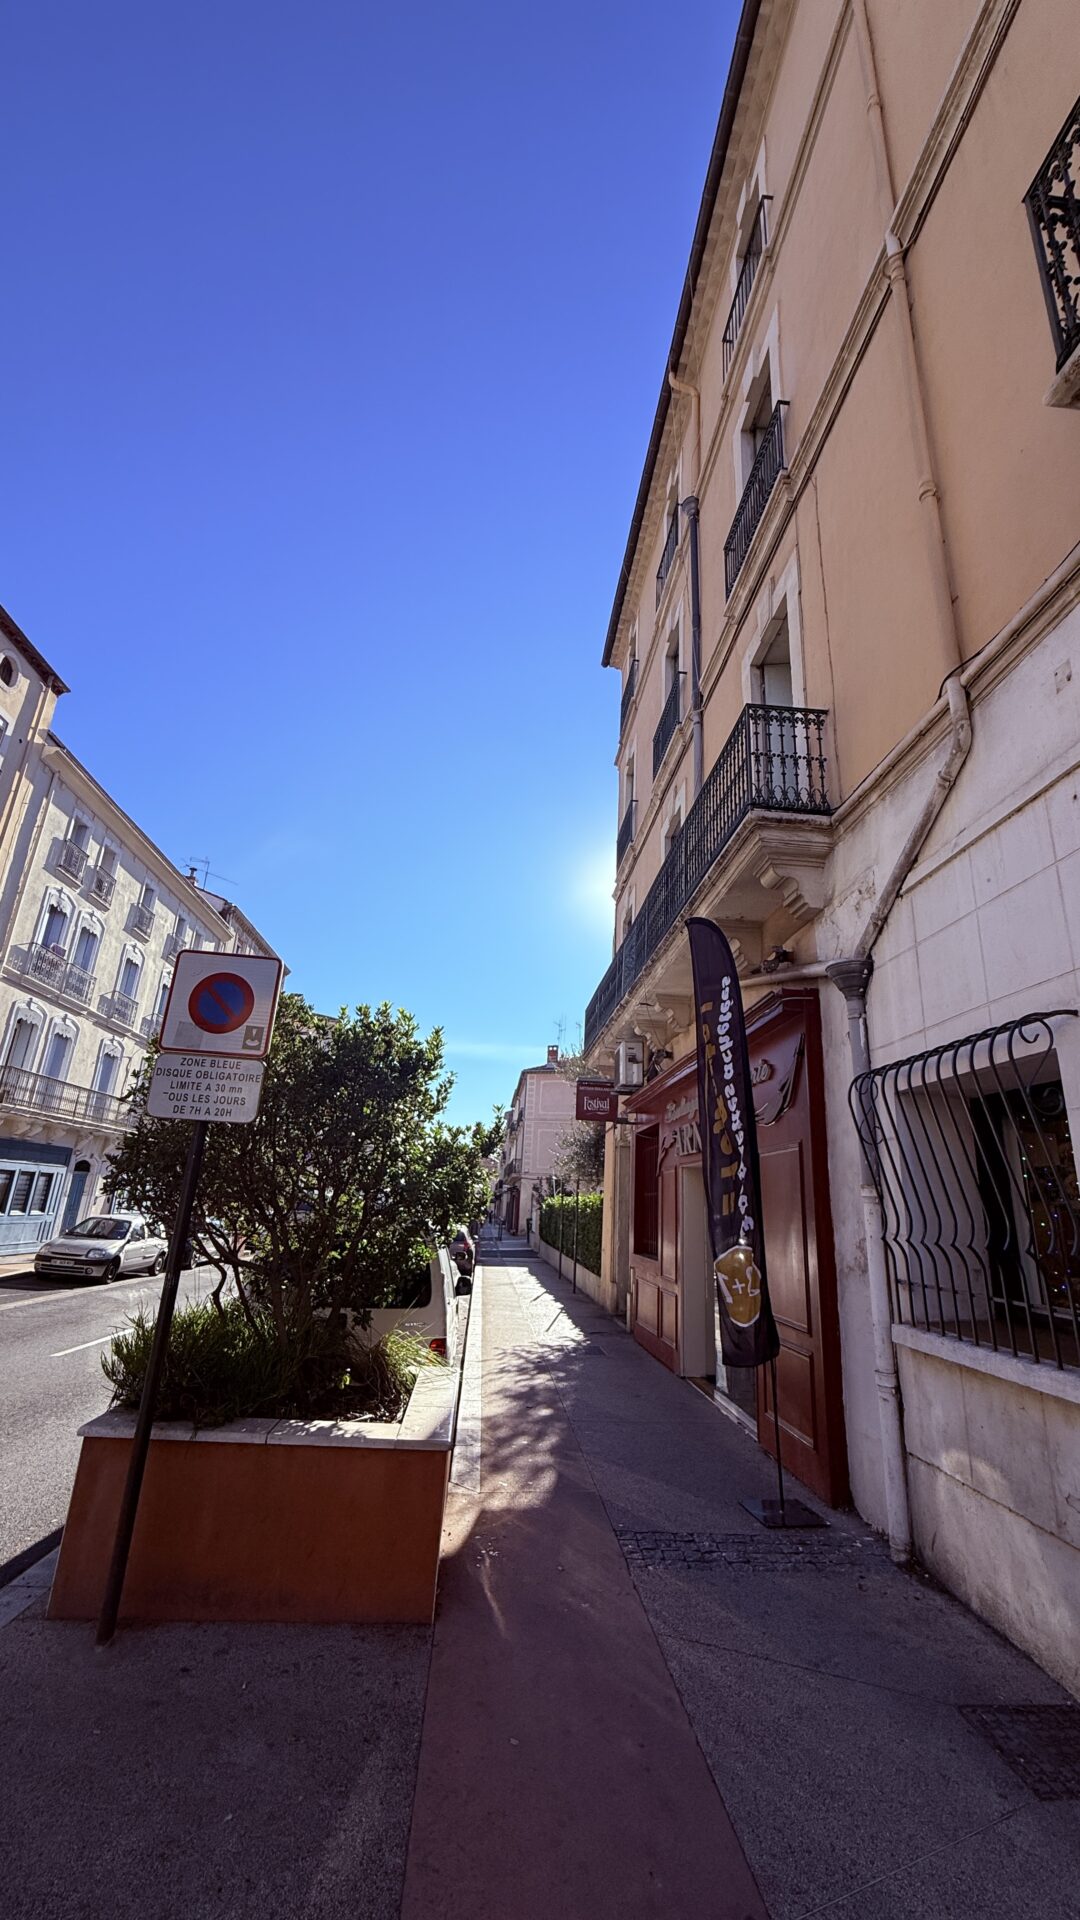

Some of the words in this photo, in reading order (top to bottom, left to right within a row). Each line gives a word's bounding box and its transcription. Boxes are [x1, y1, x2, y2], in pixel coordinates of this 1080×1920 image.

[181, 1057, 207, 1067] ZONE
[210, 1059, 242, 1070] BLEUE
[156, 1067, 192, 1078] DISQUE
[195, 1070, 261, 1083] OBLIGATOIRE
[170, 1080, 202, 1091] LIMITE
[204, 1083, 211, 1092] A
[215, 1083, 226, 1092] 30
[229, 1086, 243, 1094] mn
[191, 1094, 211, 1104] LES
[213, 1095, 246, 1106] JOURS
[172, 1104, 186, 1114] DE
[189, 1106, 201, 1115] 7H
[204, 1106, 211, 1116] A
[214, 1107, 233, 1117] 20H
